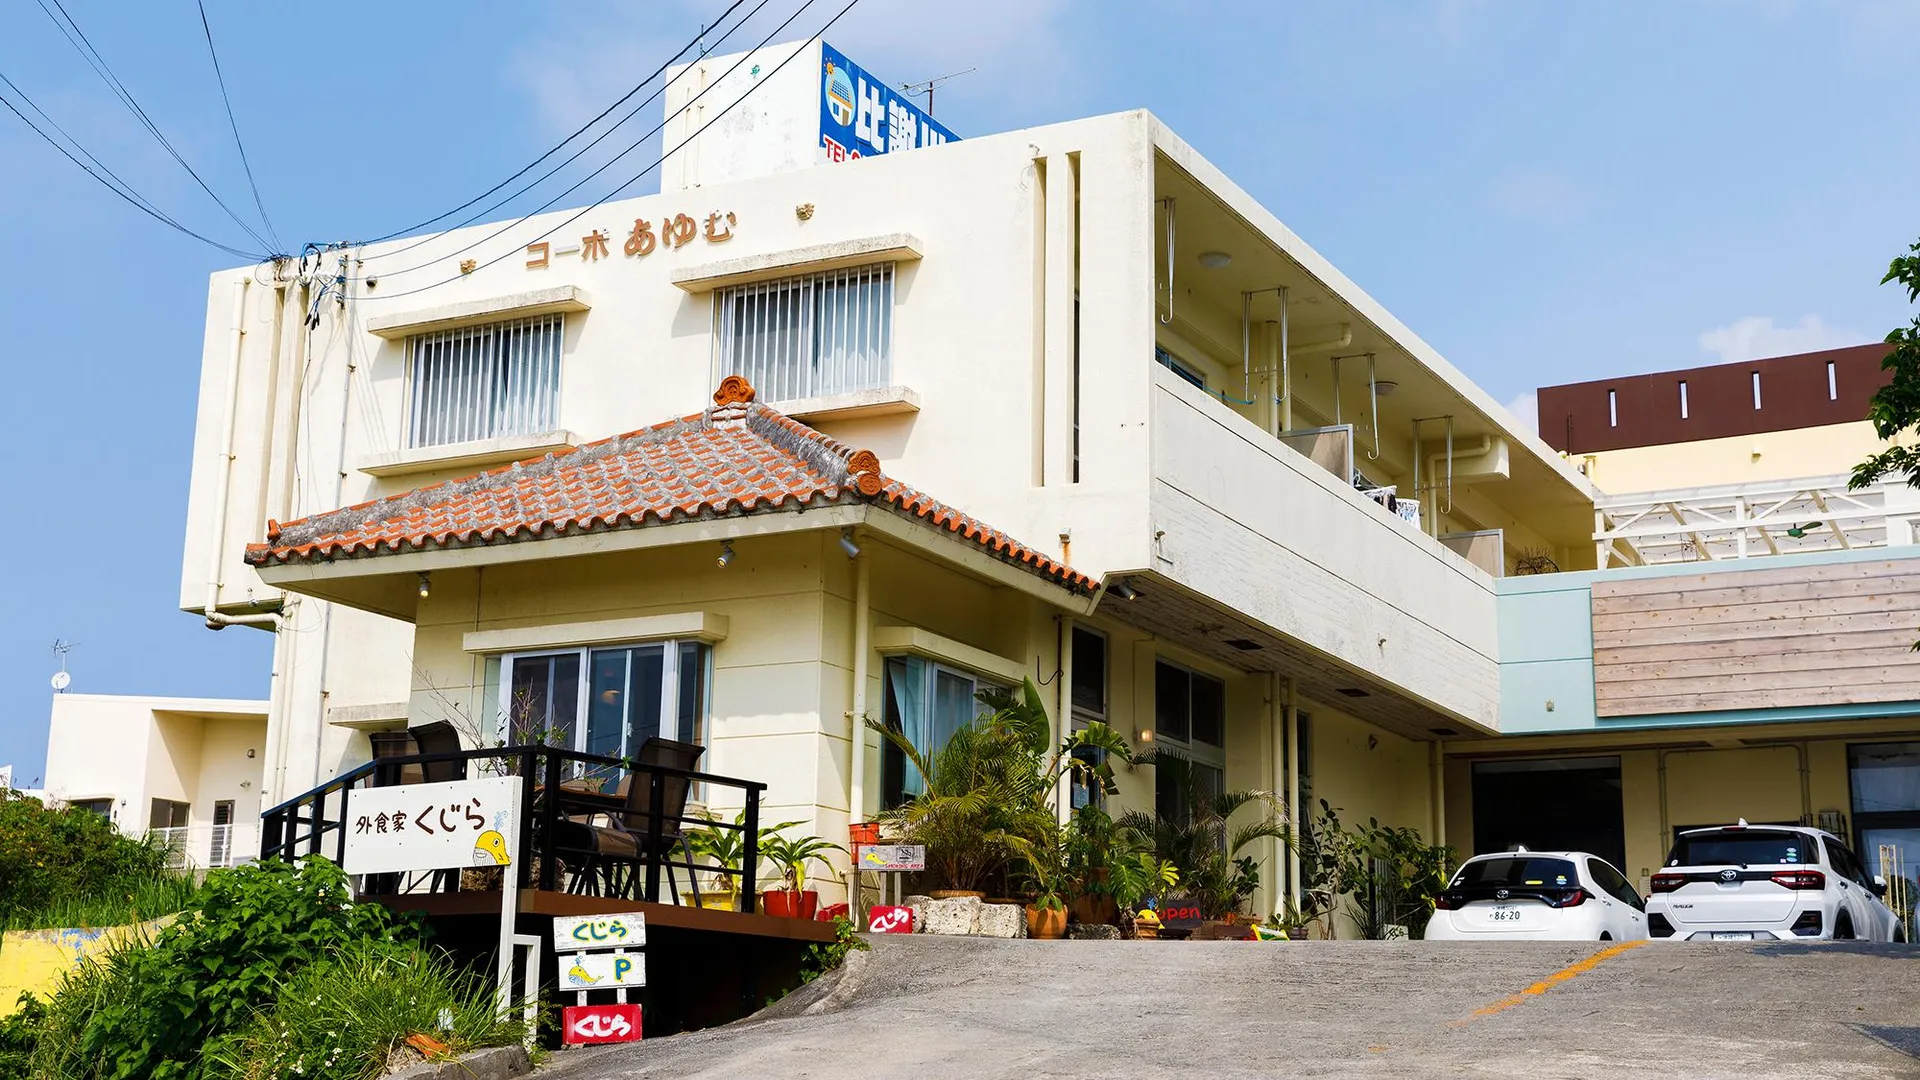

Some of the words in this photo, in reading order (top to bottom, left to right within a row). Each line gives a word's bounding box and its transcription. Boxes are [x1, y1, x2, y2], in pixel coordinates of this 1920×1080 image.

[624, 209, 738, 258] あゆむ
[355, 809, 408, 835] 外食家
[414, 797, 486, 836] くじら
[869, 908, 910, 933] くじら
[1494, 911, 1521, 920] 86-20
[572, 920, 627, 941] くじら
[615, 958, 631, 980] P
[574, 1013, 632, 1037] くじら
